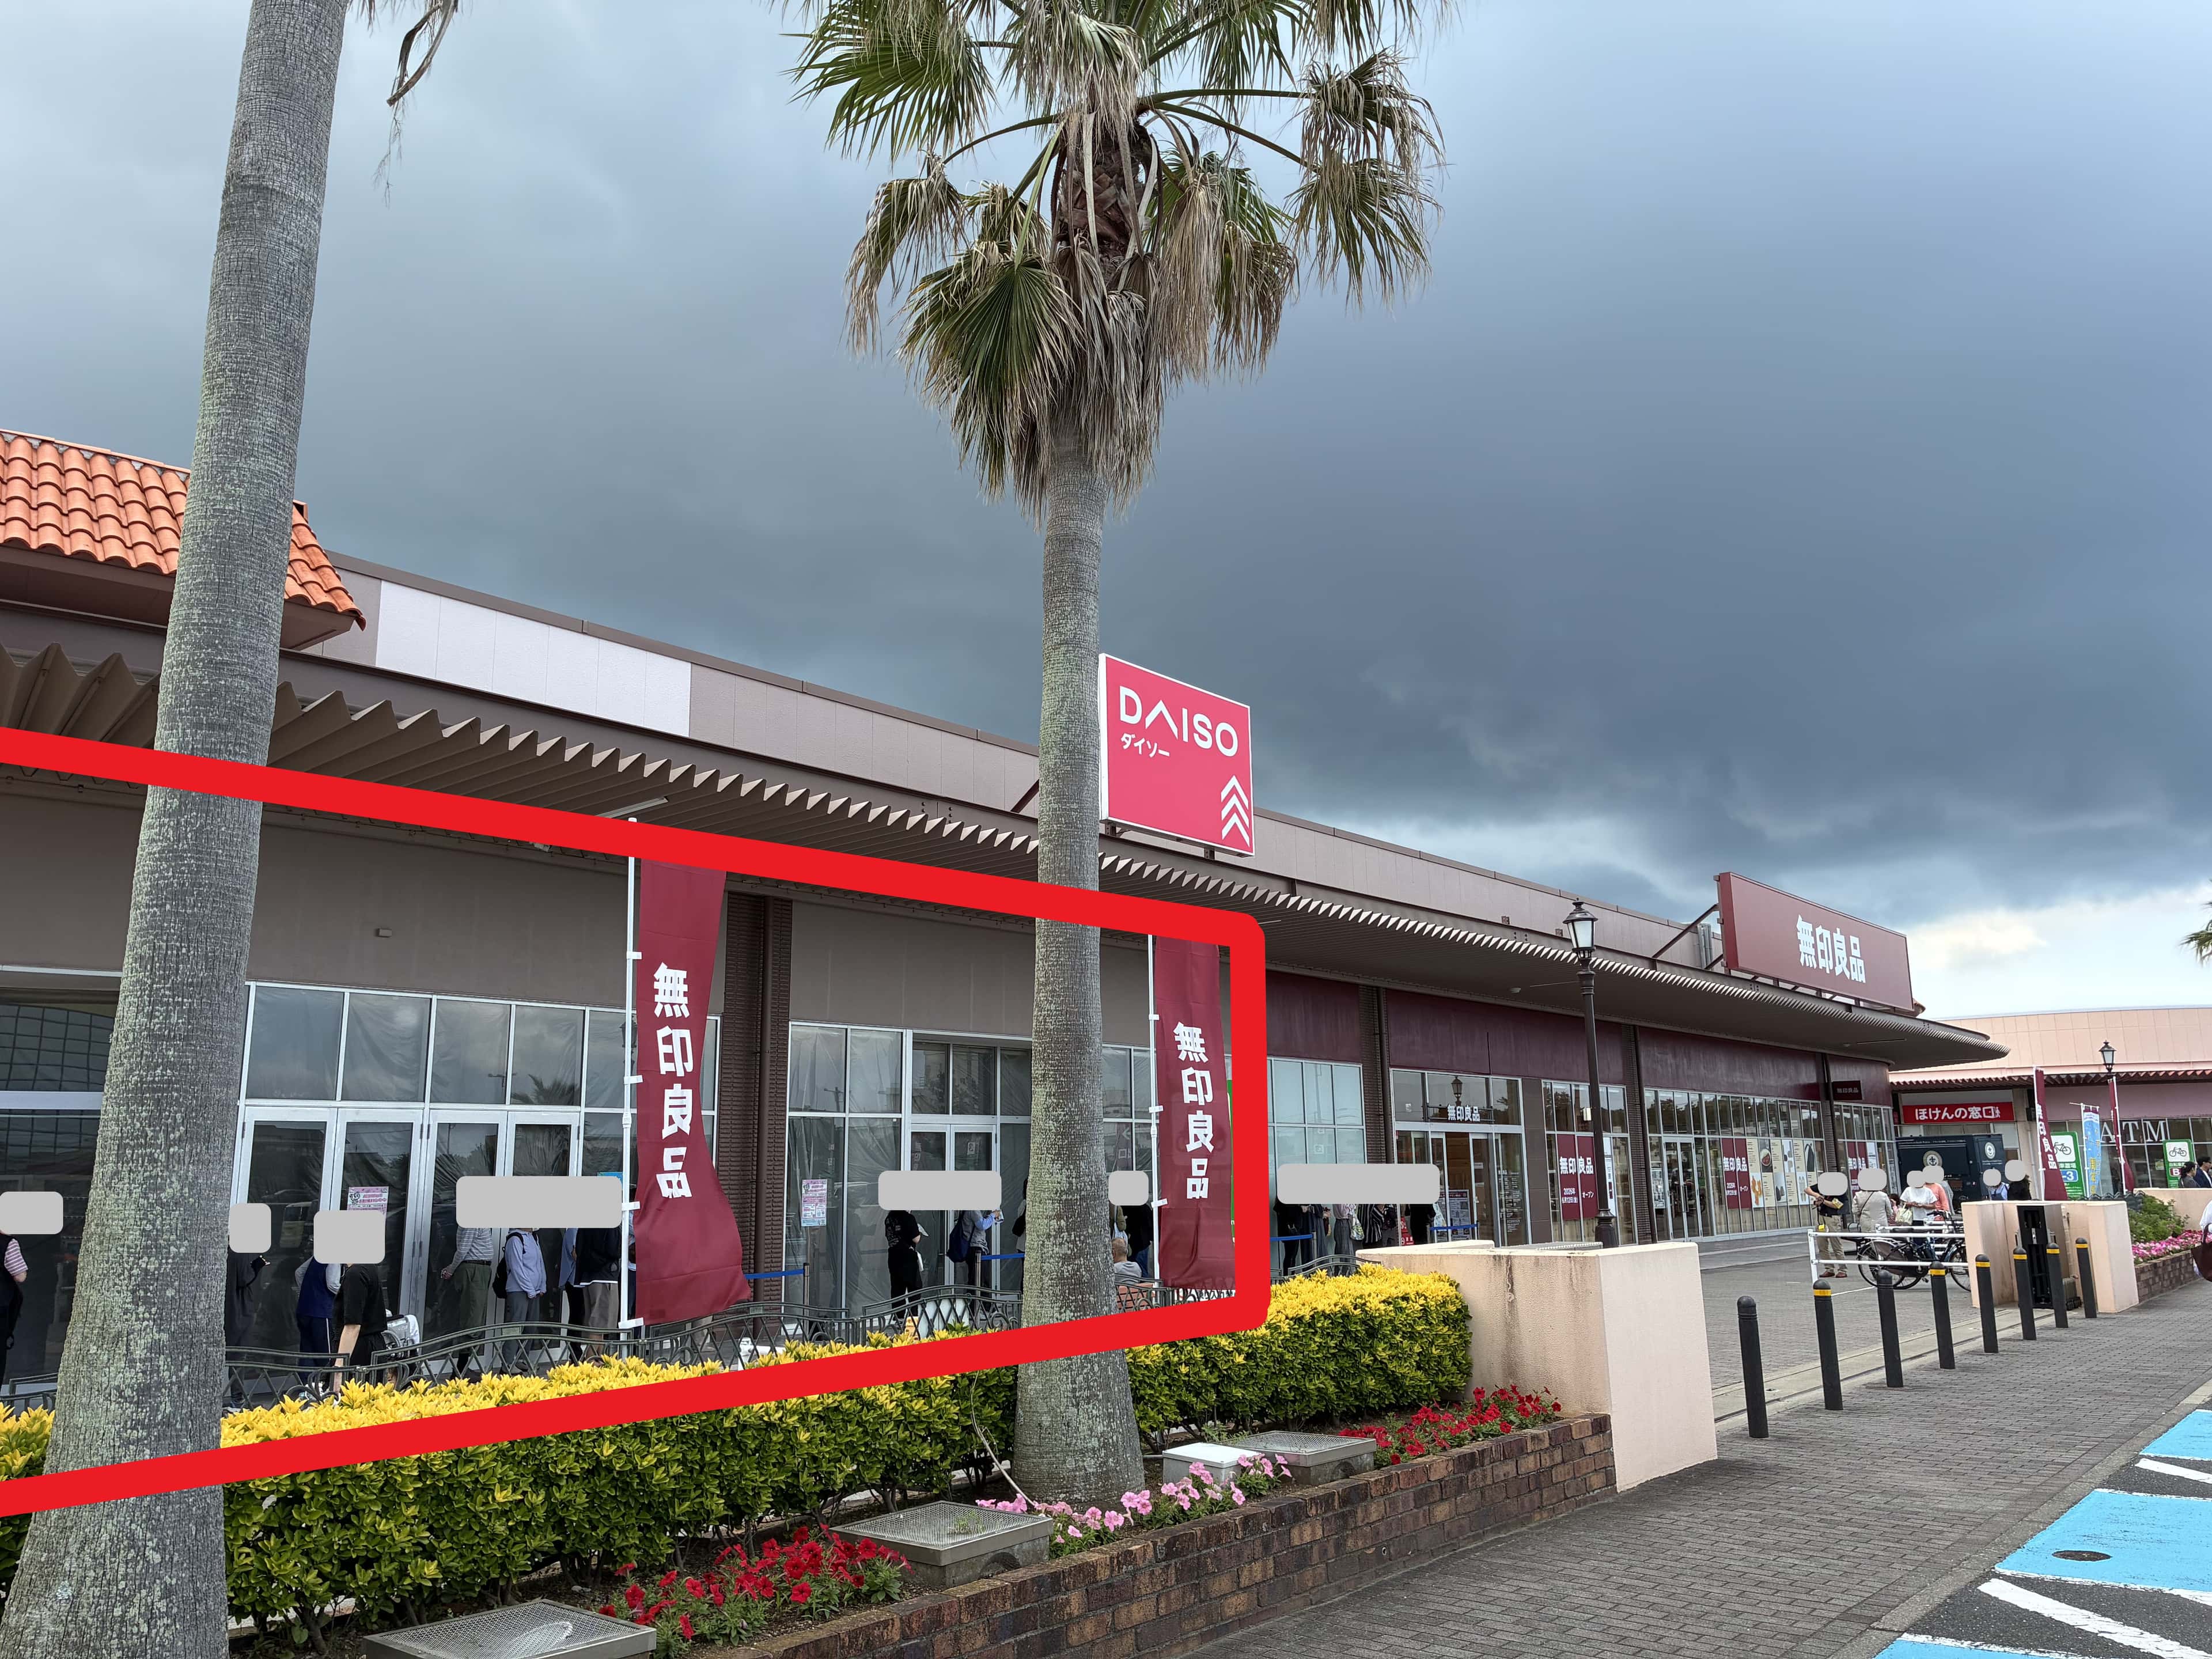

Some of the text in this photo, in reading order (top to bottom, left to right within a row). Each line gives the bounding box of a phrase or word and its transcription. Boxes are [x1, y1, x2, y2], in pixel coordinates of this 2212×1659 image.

[1119, 685, 1238, 757] DAISO
[1120, 733, 1170, 758] ダイソー
[1796, 914, 1866, 983] 無印良品
[653, 961, 693, 1199] 無印良品
[1173, 1021, 1214, 1199] 無印良品
[1448, 1104, 1480, 1122] 無印良品
[1915, 1106, 1995, 1120] ほけんの窓口
[2100, 1120, 2167, 1143] ATM
[1559, 1156, 1594, 1175] 無印良品
[1723, 1156, 1748, 1172] 無印良品
